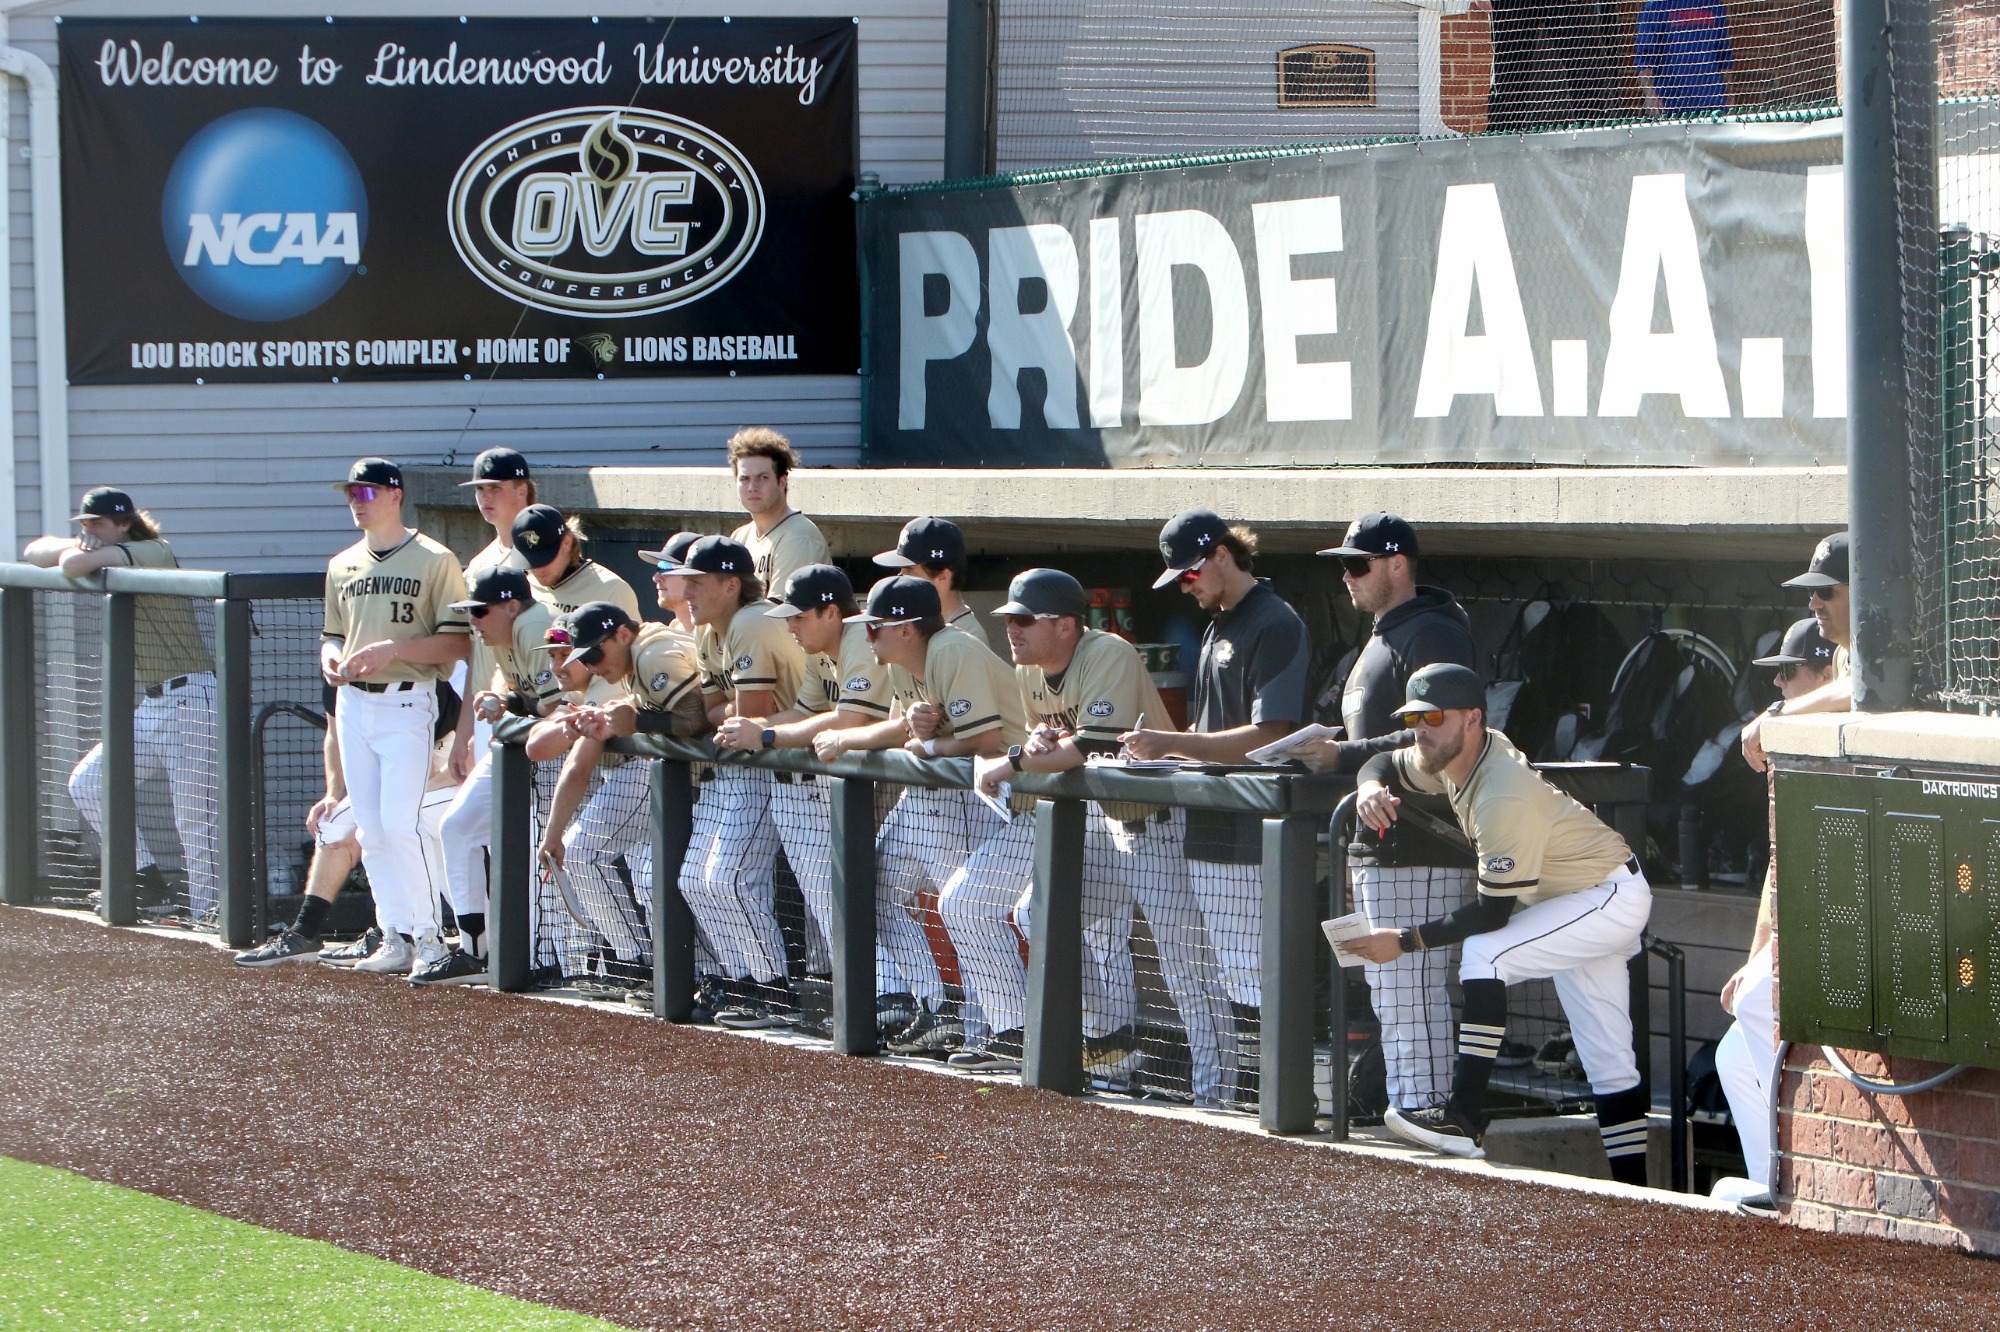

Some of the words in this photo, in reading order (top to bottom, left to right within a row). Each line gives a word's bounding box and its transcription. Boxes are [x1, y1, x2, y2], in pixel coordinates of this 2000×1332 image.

[95, 38, 279, 87] Welcome
[298, 44, 343, 86] to
[366, 41, 613, 87] Lindenwood
[632, 42, 824, 106] University
[485, 131, 562, 178] OHIO
[633, 128, 742, 190] VALLEY
[183, 212, 360, 266] NCAA
[511, 171, 697, 257] OVC
[497, 256, 715, 298] CONFERENCE
[898, 195, 1353, 430] PRIDE
[131, 342, 173, 369] LOU
[178, 341, 258, 368] BROCK
[261, 340, 351, 367] SPORTS
[355, 339, 458, 366] COMPLEX
[476, 338, 539, 364] HOME
[543, 337, 571, 363] OF
[624, 336, 688, 362] LIONS
[692, 335, 798, 361] BASEBALL
[390, 600, 414, 624] 13
[1922, 780, 1998, 799] DAKTRONICS
